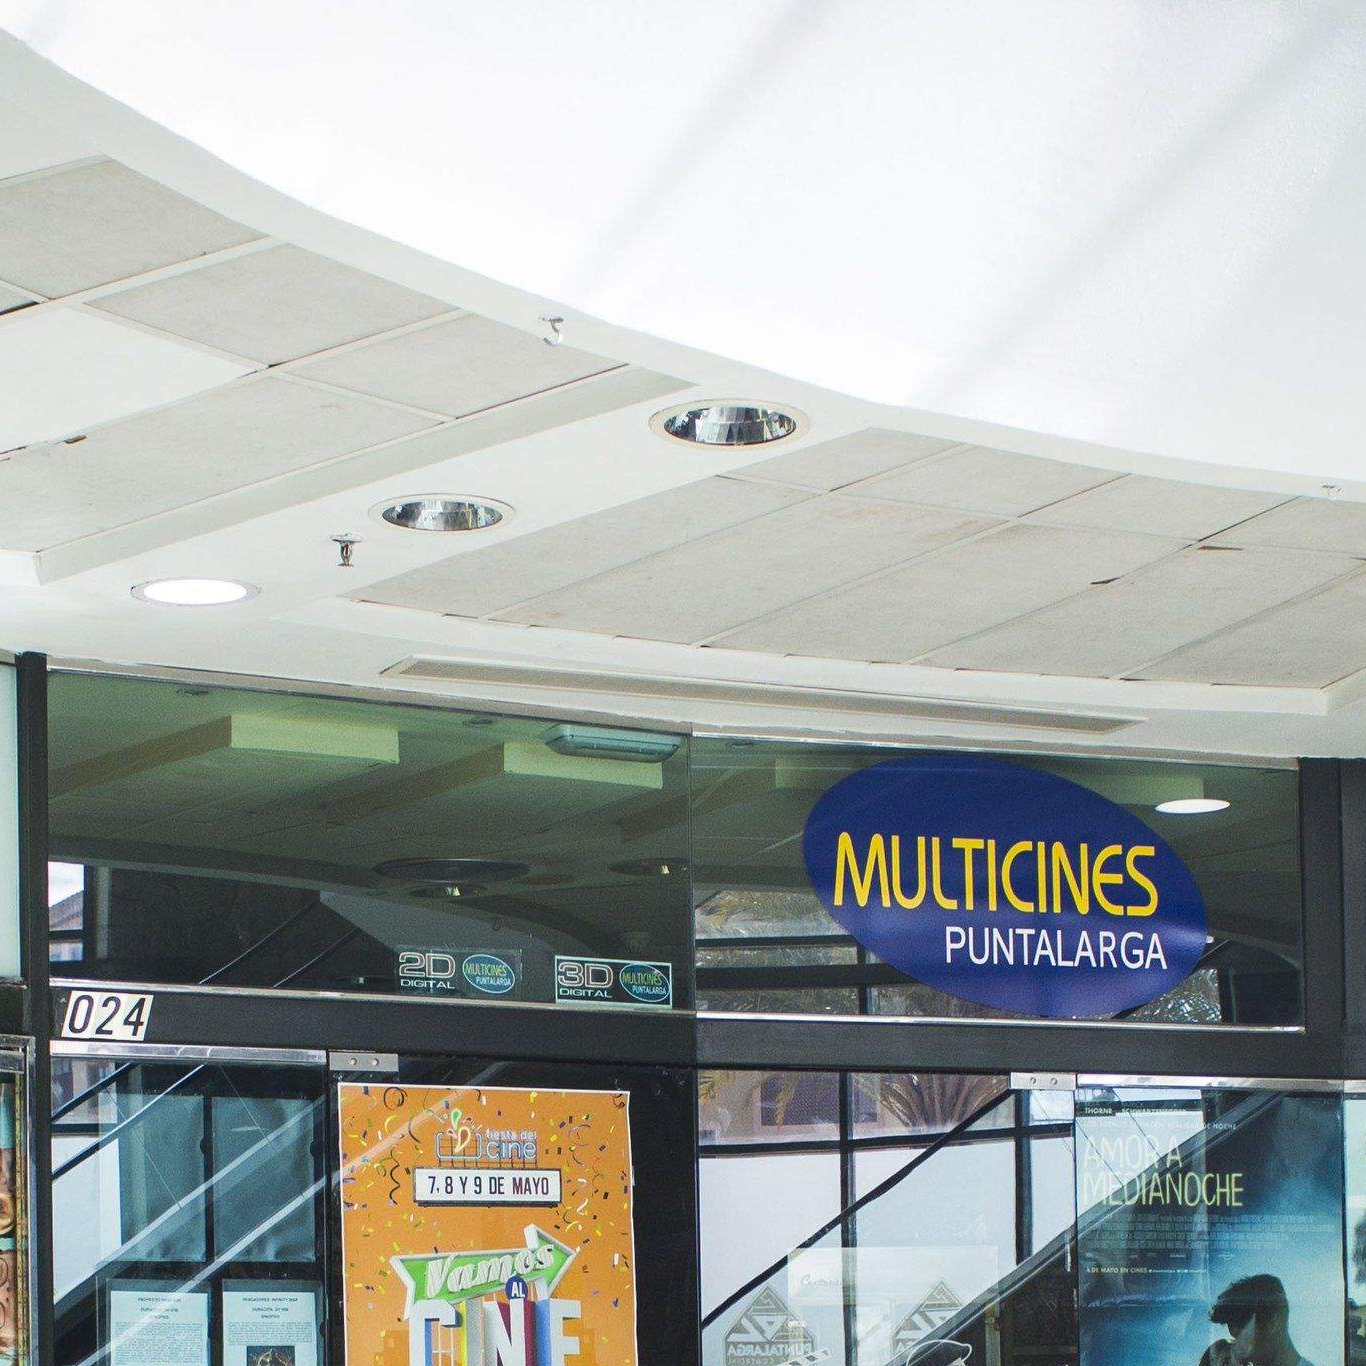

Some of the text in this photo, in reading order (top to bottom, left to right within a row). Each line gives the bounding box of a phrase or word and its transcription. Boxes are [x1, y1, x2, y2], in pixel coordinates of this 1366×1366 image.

[834, 832, 1158, 916] MULTICINES
[944, 926, 1167, 969] PUNTALARGA
[399, 952, 455, 979] 2D
[465, 962, 506, 977] MULTICINES
[558, 962, 613, 988] 3D
[400, 979, 455, 989] DIGITAL
[475, 977, 512, 986] PUNTALARGA
[622, 971, 662, 986] MULTICINES
[560, 988, 613, 998] DIGITAL
[632, 985, 666, 994] PUNTALARGA
[69, 995, 146, 1036] 024
[486, 1128, 537, 1139] fiesta del
[487, 1140, 536, 1159] cine
[1166, 1143, 1182, 1167] A
[445, 1176, 453, 1194] 8
[460, 1176, 468, 1194] Y
[474, 1176, 482, 1194] 9
[489, 1177, 504, 1194] DE
[512, 1178, 549, 1195] MAYO
[1083, 1172, 1244, 1207] MEDIANOCHE
[426, 1245, 554, 1298] Vamos
[510, 1282, 526, 1298] AL
